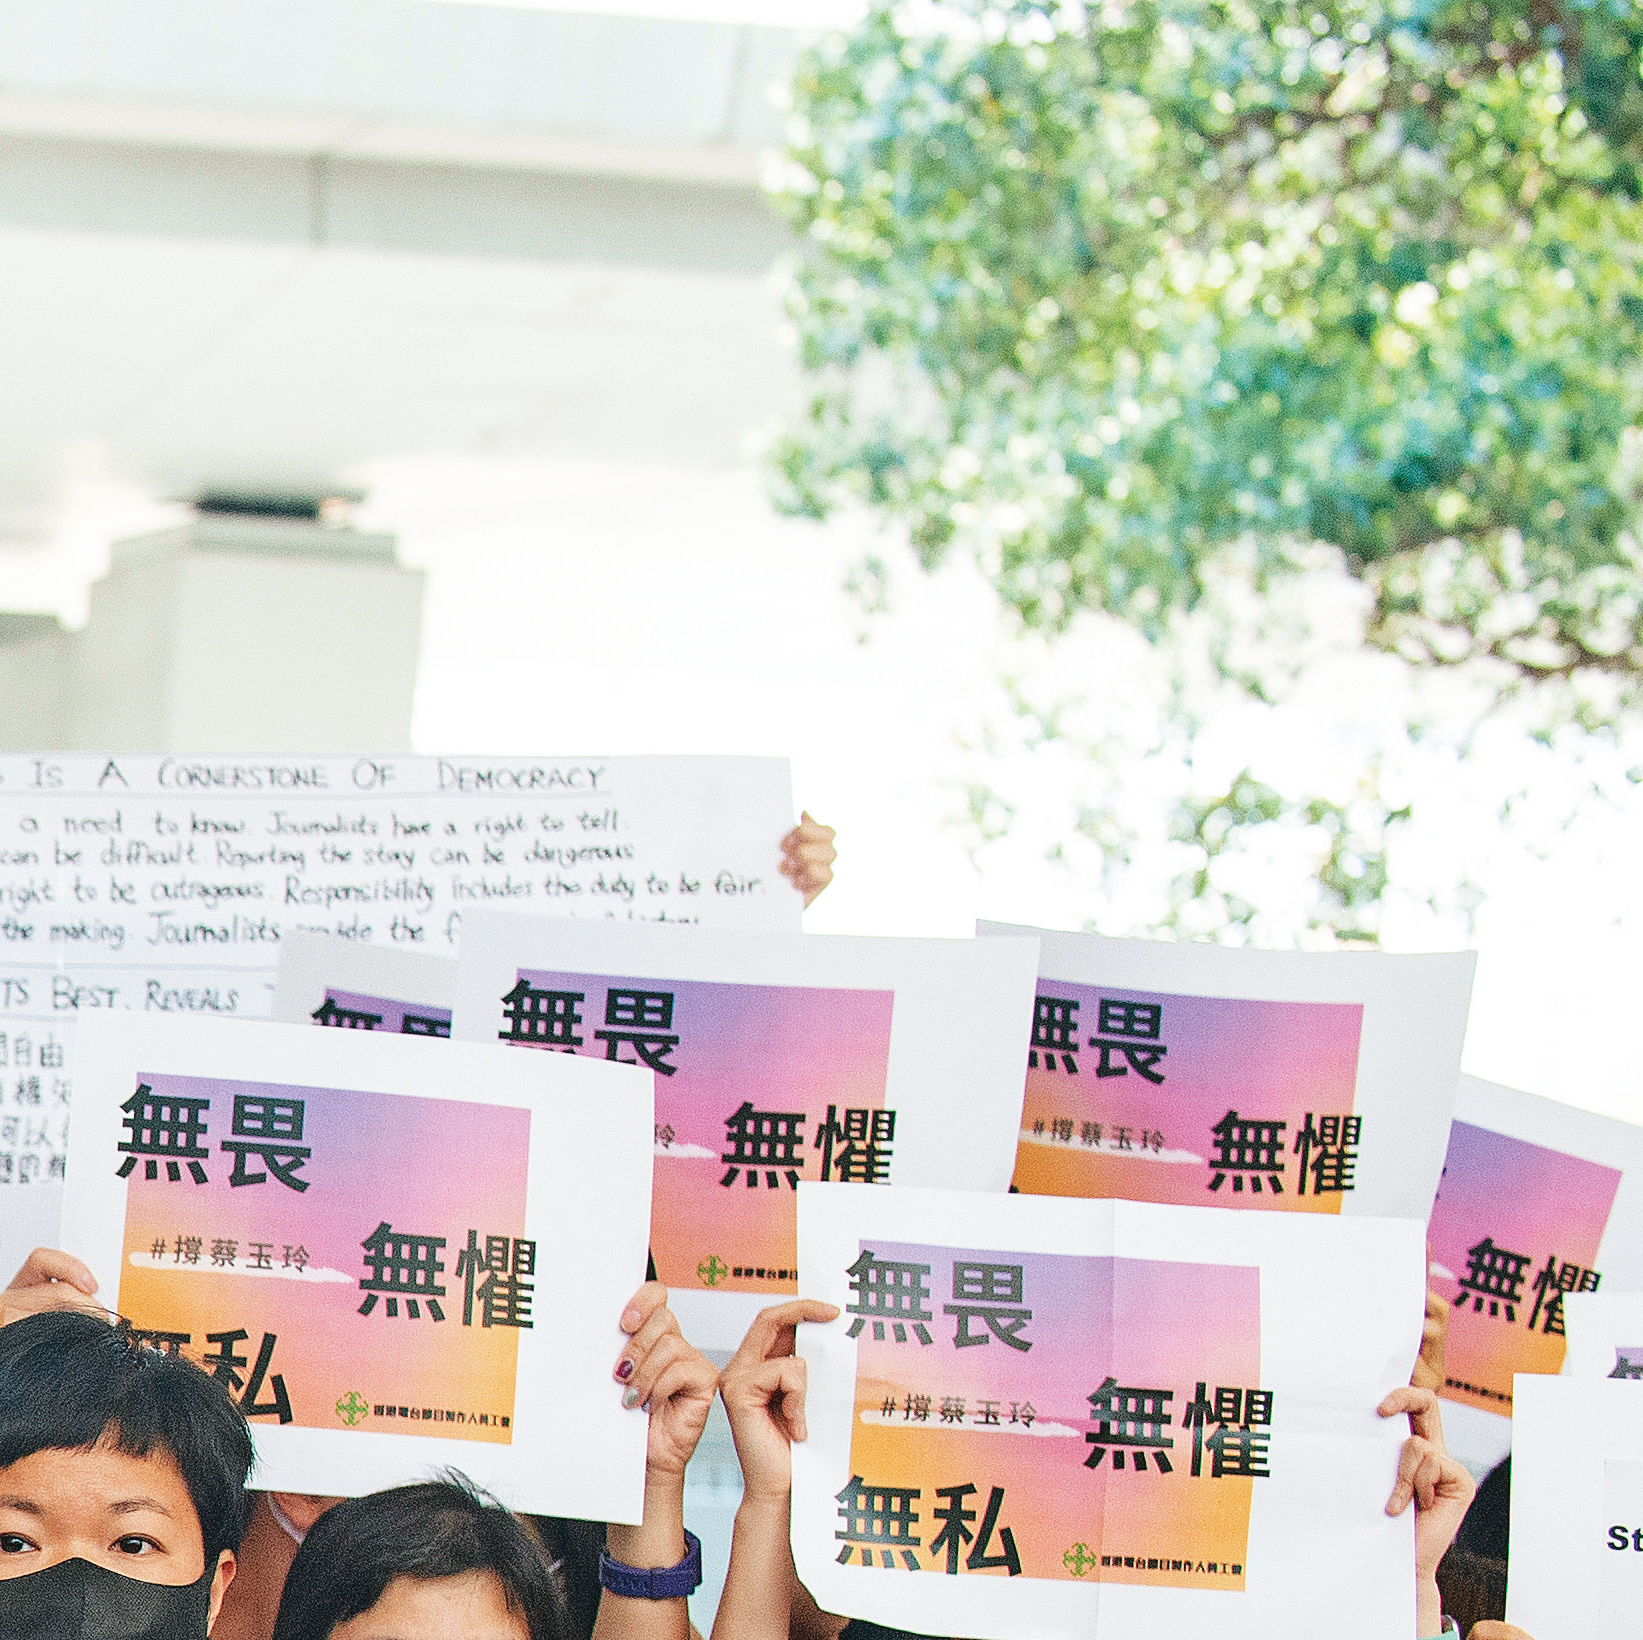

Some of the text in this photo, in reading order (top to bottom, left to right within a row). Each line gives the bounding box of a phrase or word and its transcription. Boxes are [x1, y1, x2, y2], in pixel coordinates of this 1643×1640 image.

[98, 759, 130, 788] A
[437, 758, 605, 790] DEMOCRACY
[19, 817, 39, 833] a
[64, 808, 122, 835] need
[155, 808, 179, 835] to
[445, 822, 457, 836] a
[541, 814, 565, 831] to
[320, 843, 351, 862] the
[431, 848, 469, 865] can
[75, 875, 97, 902] to
[646, 872, 669, 895] to
[390, 913, 424, 942] the
[498, 979, 680, 1077] 無畏
[1028, 996, 1168, 1085] 無畏
[116, 1083, 311, 1193] 無畏
[719, 1101, 896, 1191] 無懼
[1208, 1110, 1362, 1196] 無懼
[357, 1221, 537, 1329] 無懼
[845, 1249, 1033, 1352] 無畏
[1083, 1377, 1274, 1478] 無懼
[834, 1475, 1022, 1576] 無私
